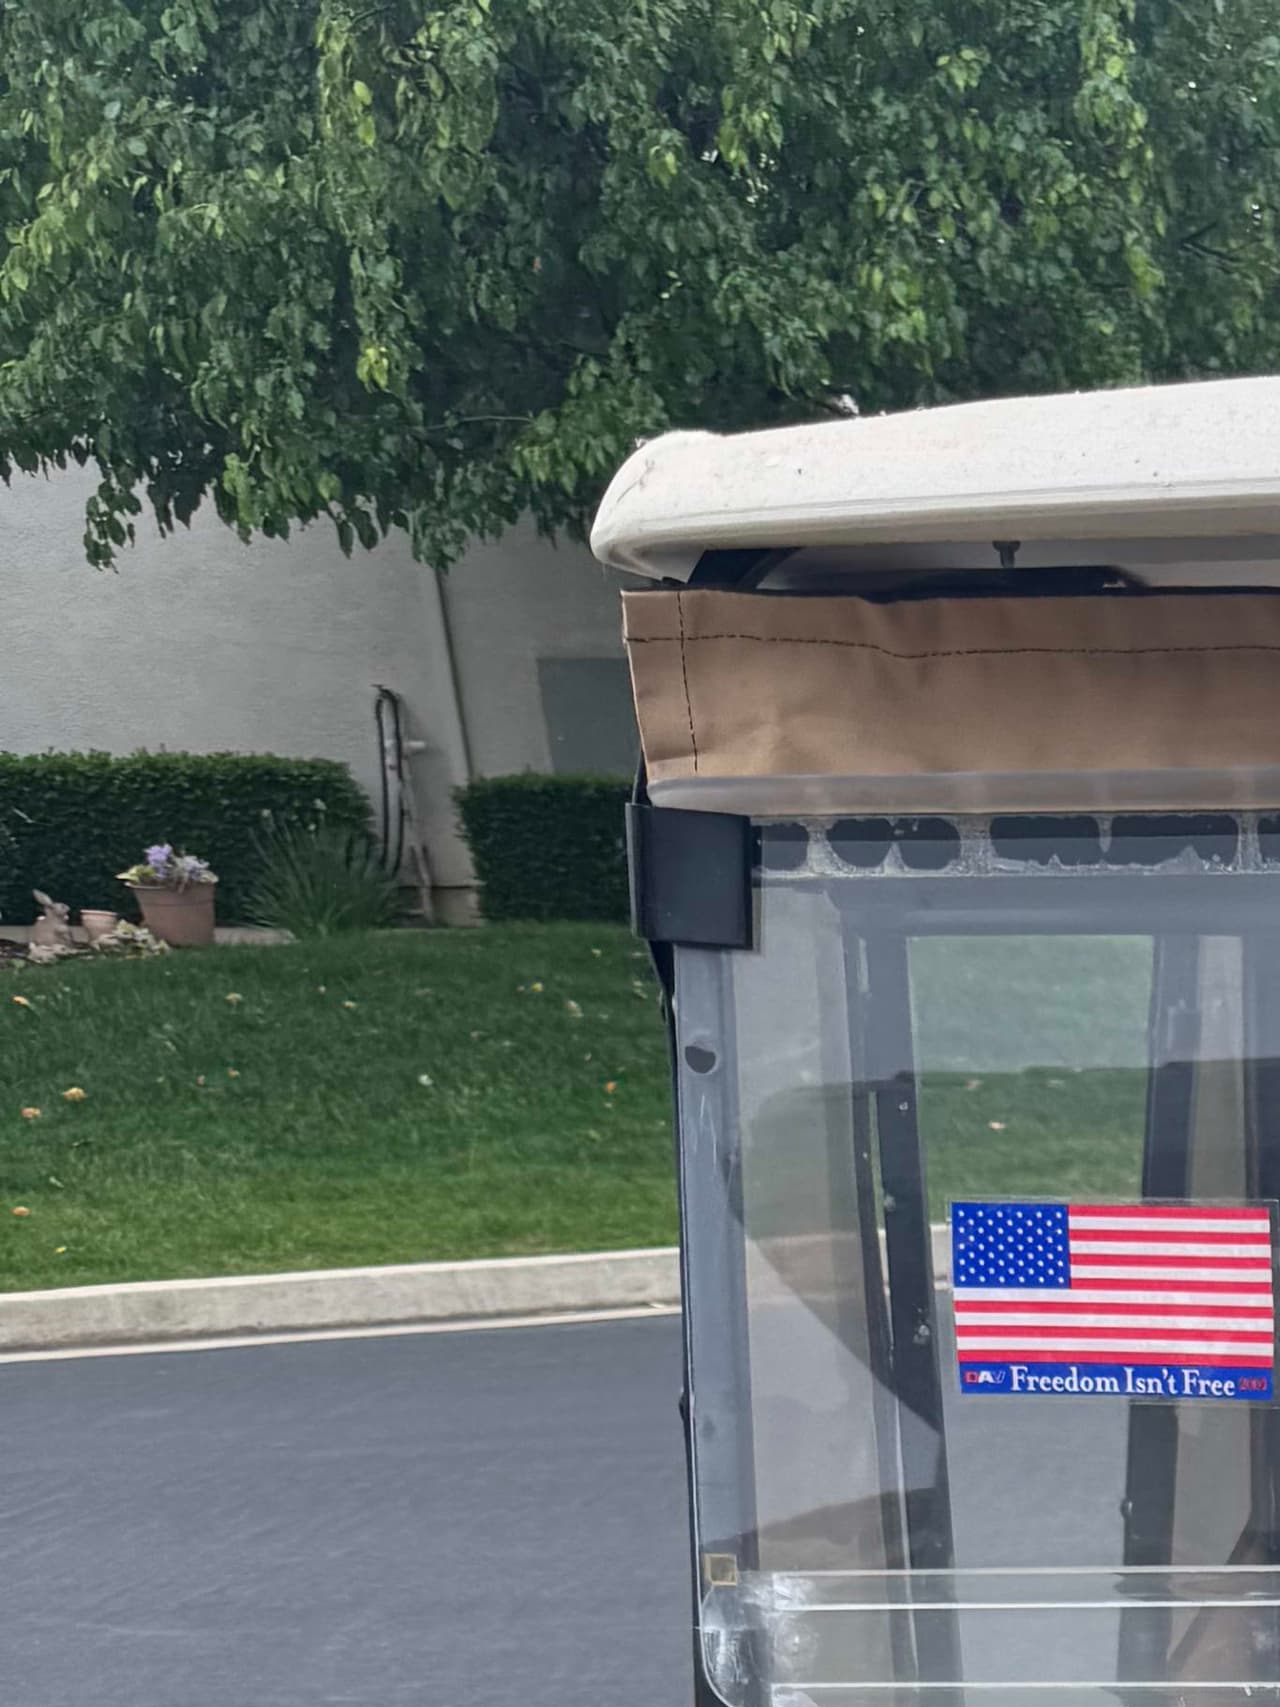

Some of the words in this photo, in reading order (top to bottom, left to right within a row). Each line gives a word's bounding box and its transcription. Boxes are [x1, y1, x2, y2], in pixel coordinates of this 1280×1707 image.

[1009, 1365, 1120, 1393] Freedom
[1124, 1367, 1179, 1395] Isn't
[1182, 1368, 1236, 1397] Free
